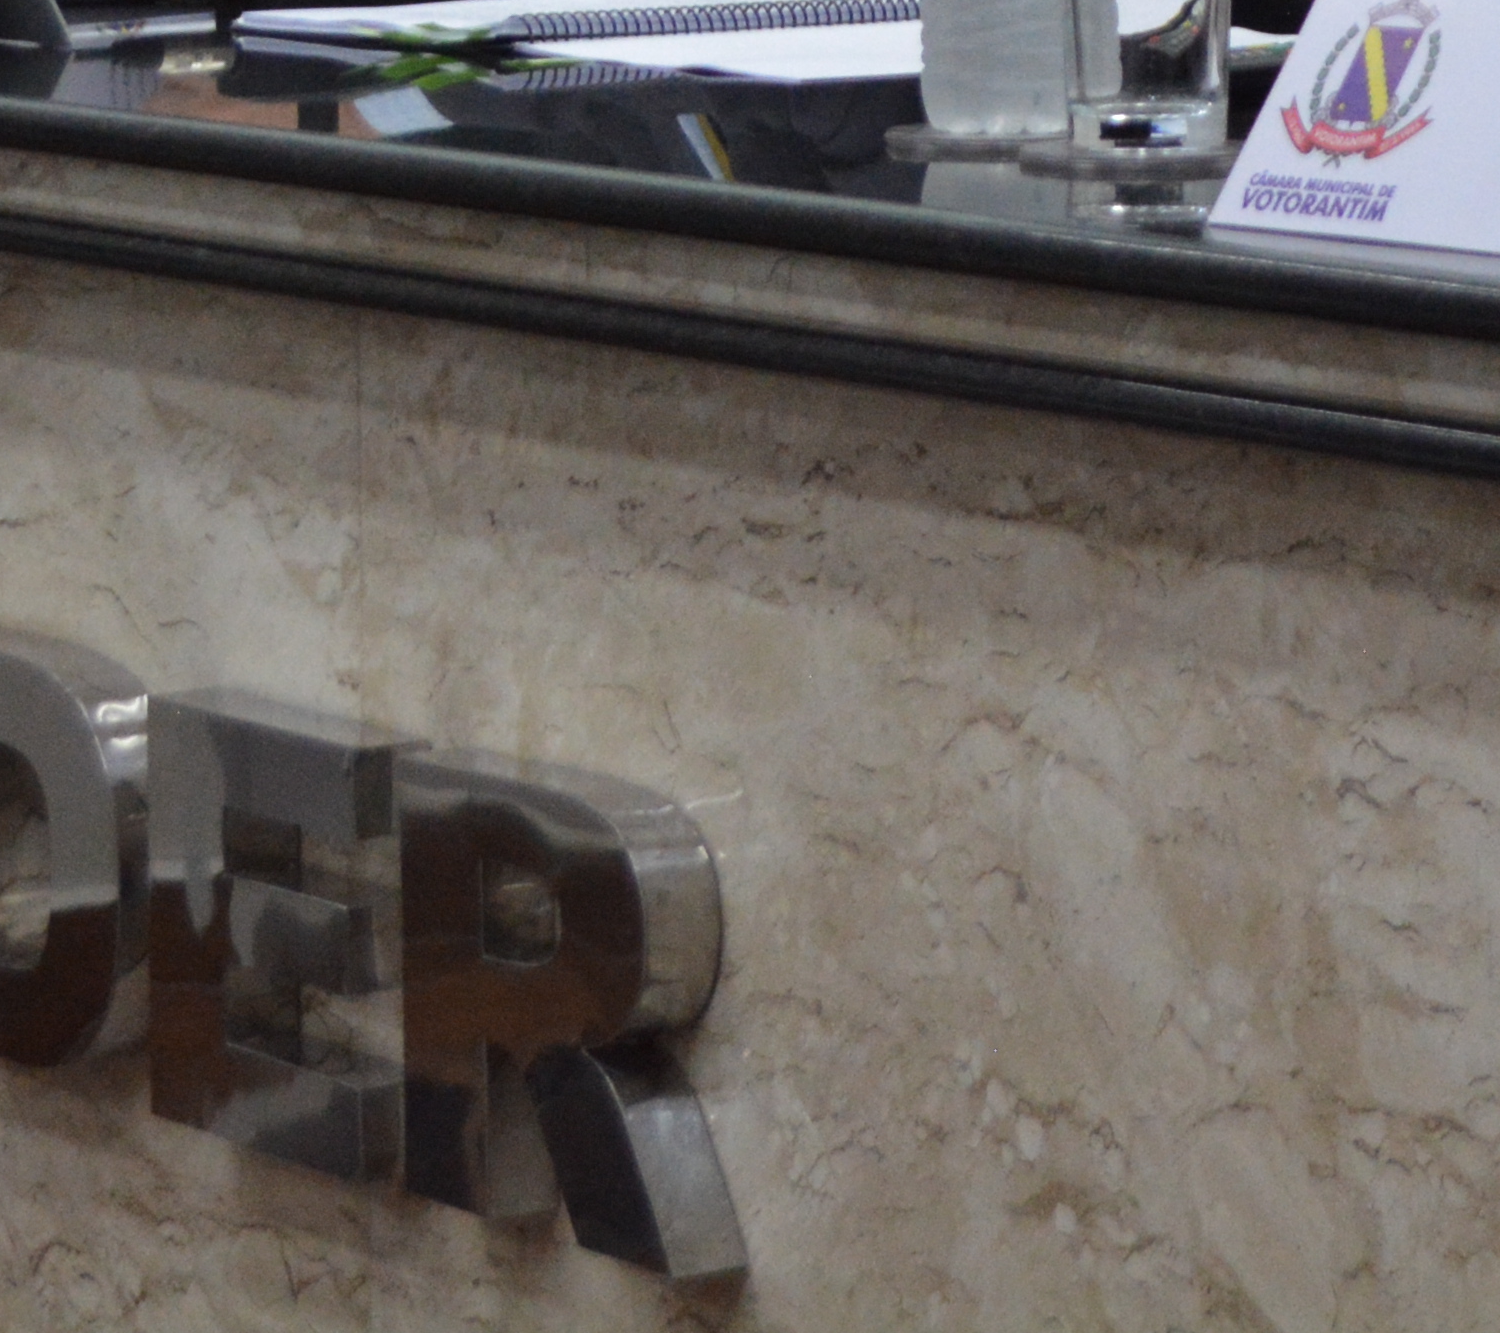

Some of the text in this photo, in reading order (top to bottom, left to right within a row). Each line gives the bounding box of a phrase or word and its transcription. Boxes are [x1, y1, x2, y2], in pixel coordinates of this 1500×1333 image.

[1303, 177, 1376, 197] MUNICIPAL
[1377, 184, 1397, 199] DE
[1241, 187, 1390, 222] VOTORANTIM
